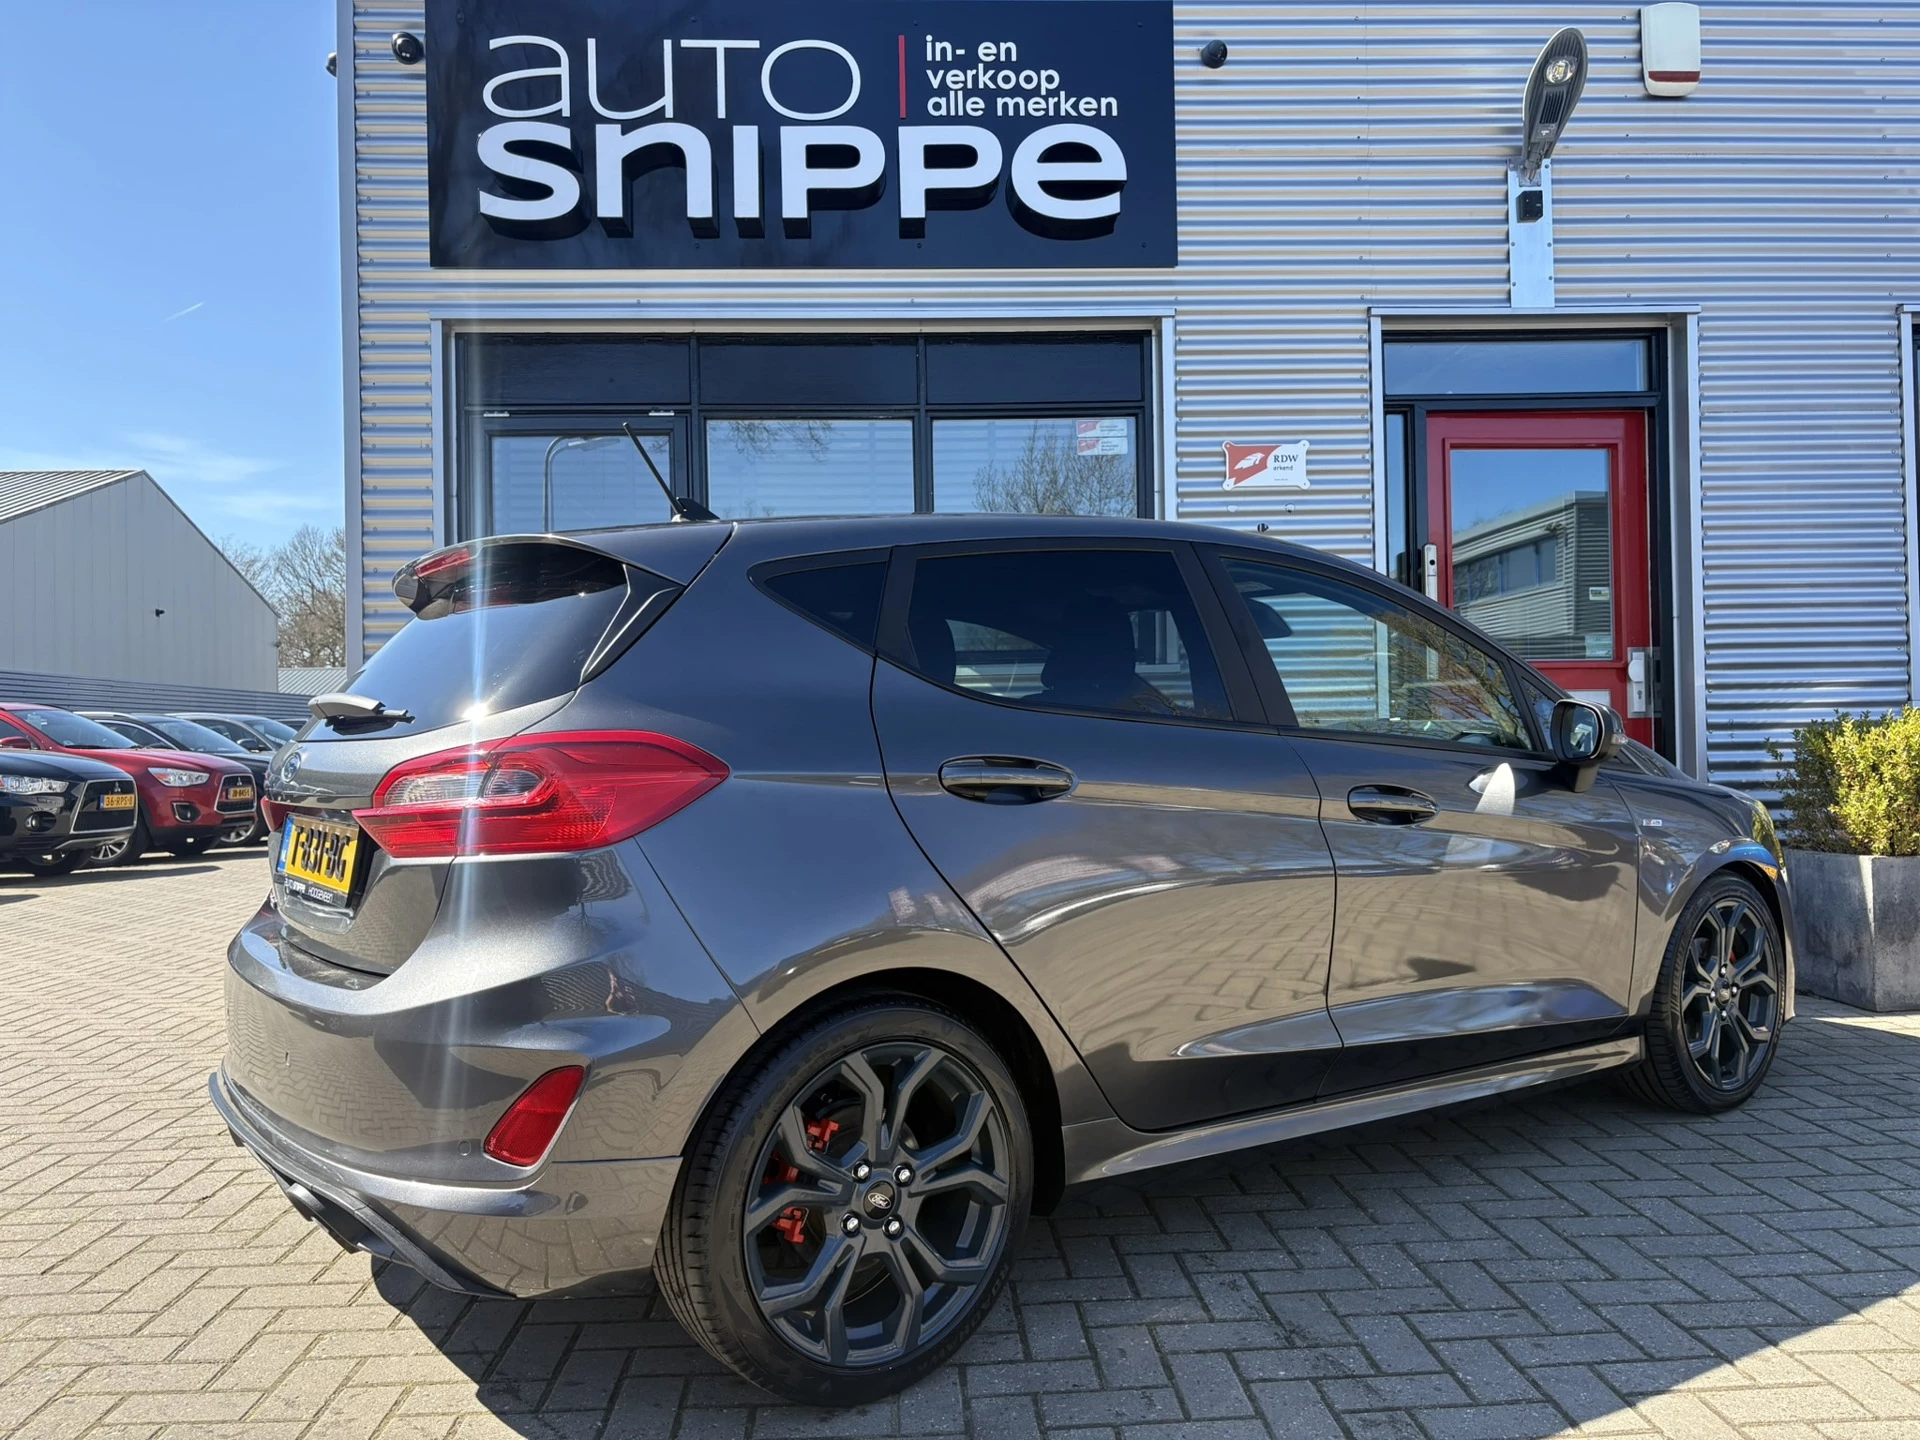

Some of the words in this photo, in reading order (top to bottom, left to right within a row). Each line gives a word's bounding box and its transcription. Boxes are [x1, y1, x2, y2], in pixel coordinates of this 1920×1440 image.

[925, 34, 966, 62] in-
[977, 41, 1017, 62] en
[925, 62, 1060, 97] verkoop
[927, 90, 986, 117] alle
[996, 96, 1118, 117] merken
[1273, 454, 1298, 463] RDW
